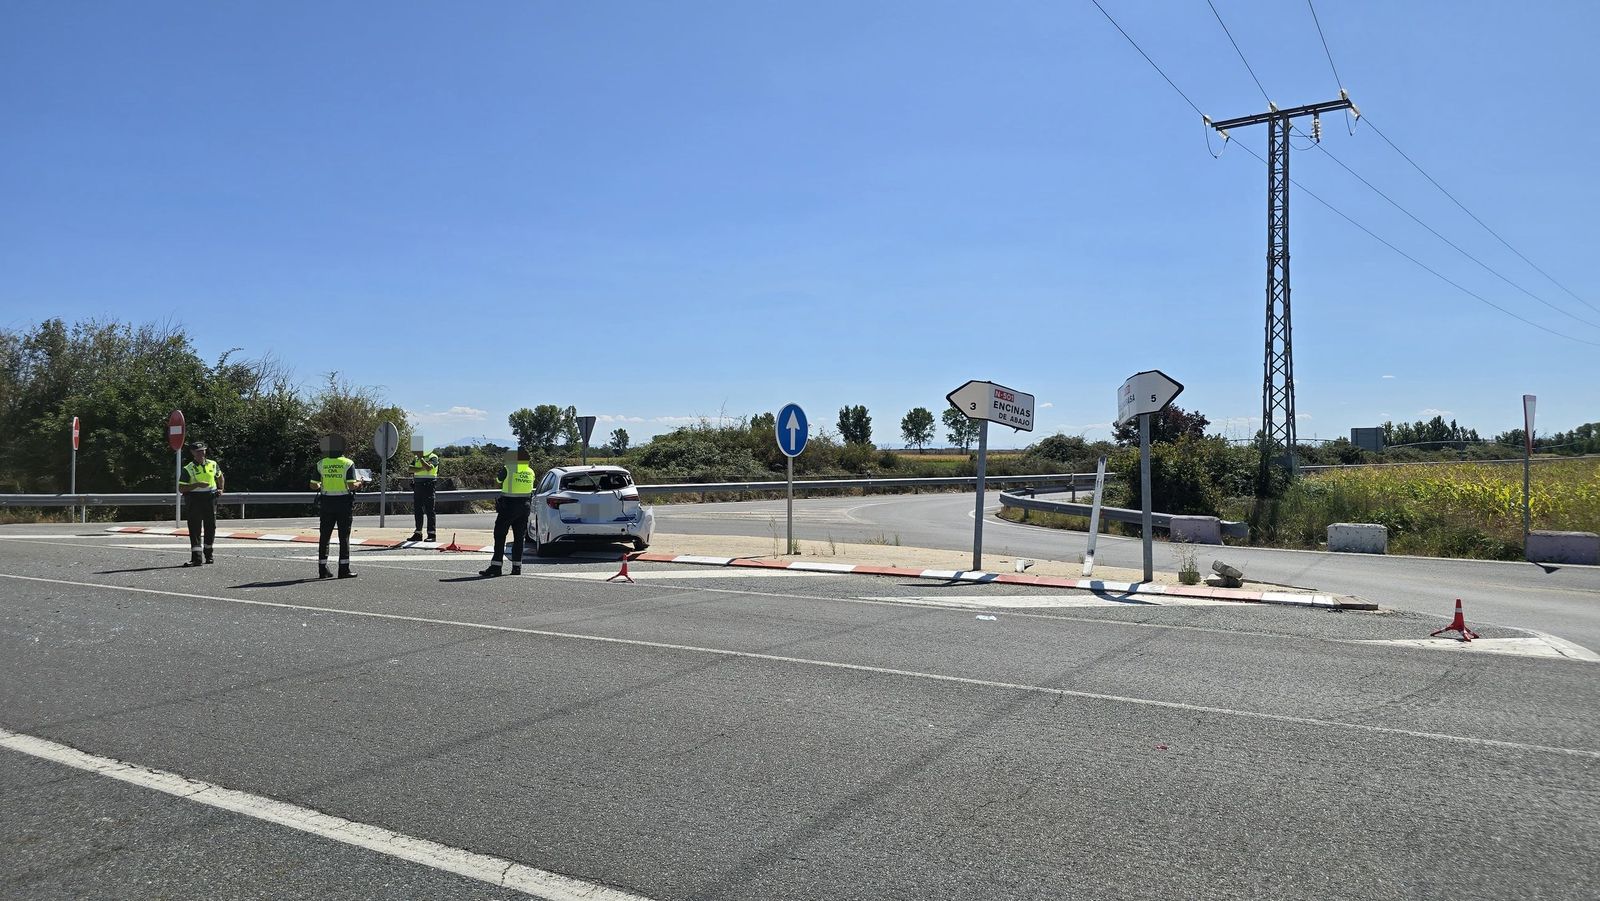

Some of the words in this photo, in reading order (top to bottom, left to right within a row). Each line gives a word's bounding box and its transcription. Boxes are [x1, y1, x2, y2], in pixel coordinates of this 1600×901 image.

[1150, 394, 1157, 402] 5
[970, 402, 976, 410] 3
[993, 401, 1031, 418] ENCINAS
[998, 412, 1007, 421] DE
[1009, 416, 1030, 426] ABAJO
